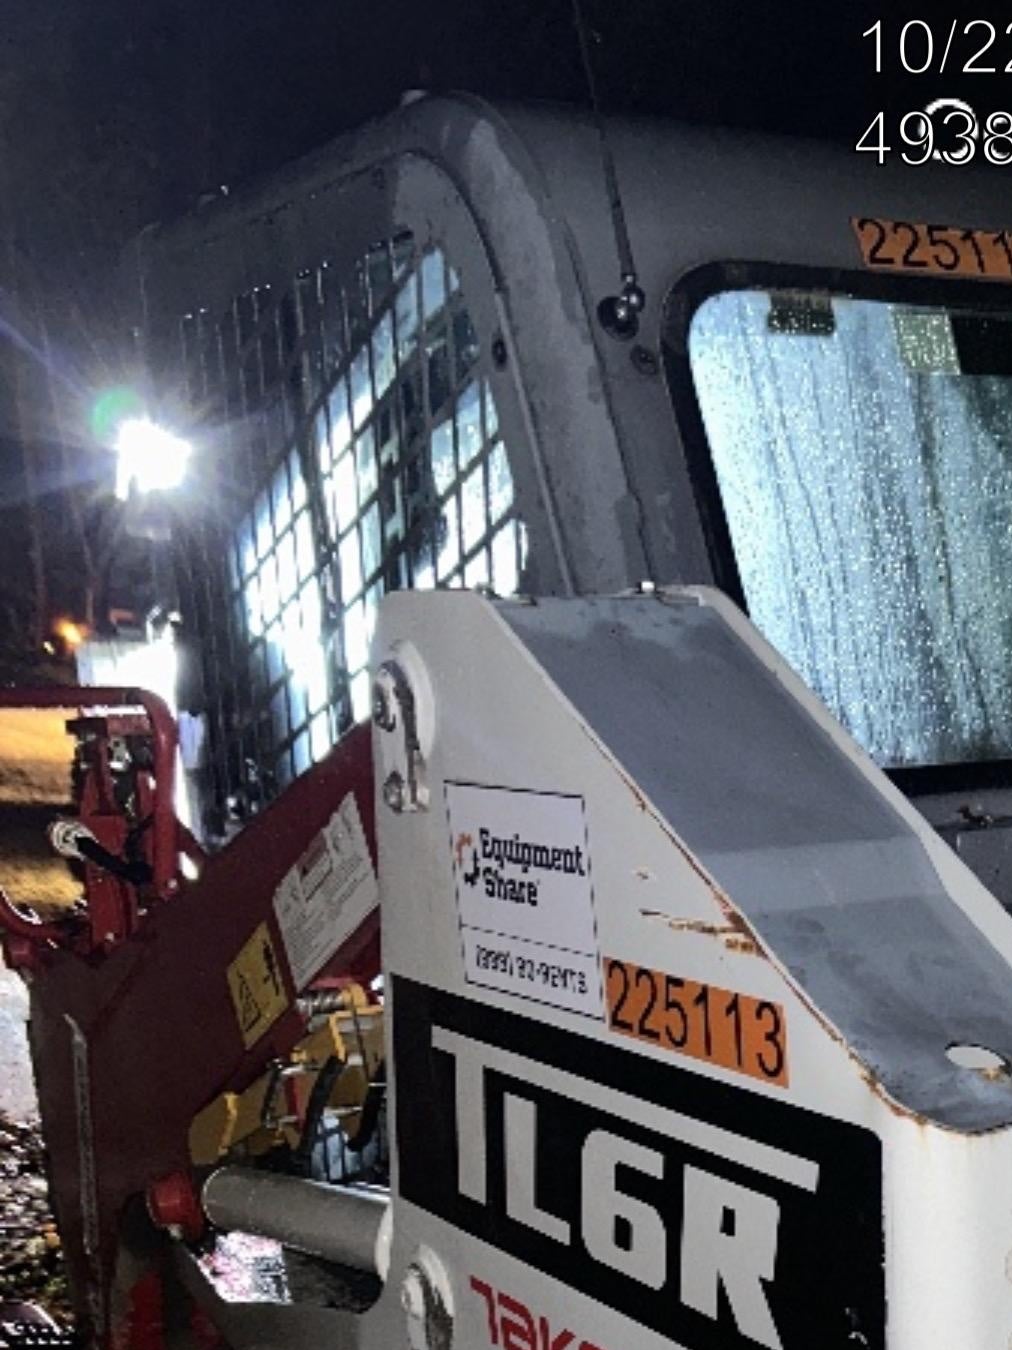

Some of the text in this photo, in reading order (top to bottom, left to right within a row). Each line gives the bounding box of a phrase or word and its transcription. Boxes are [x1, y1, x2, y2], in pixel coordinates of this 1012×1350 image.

[479, 827, 586, 877] Equipment
[482, 866, 539, 907] Share
[607, 960, 784, 1079] 225113
